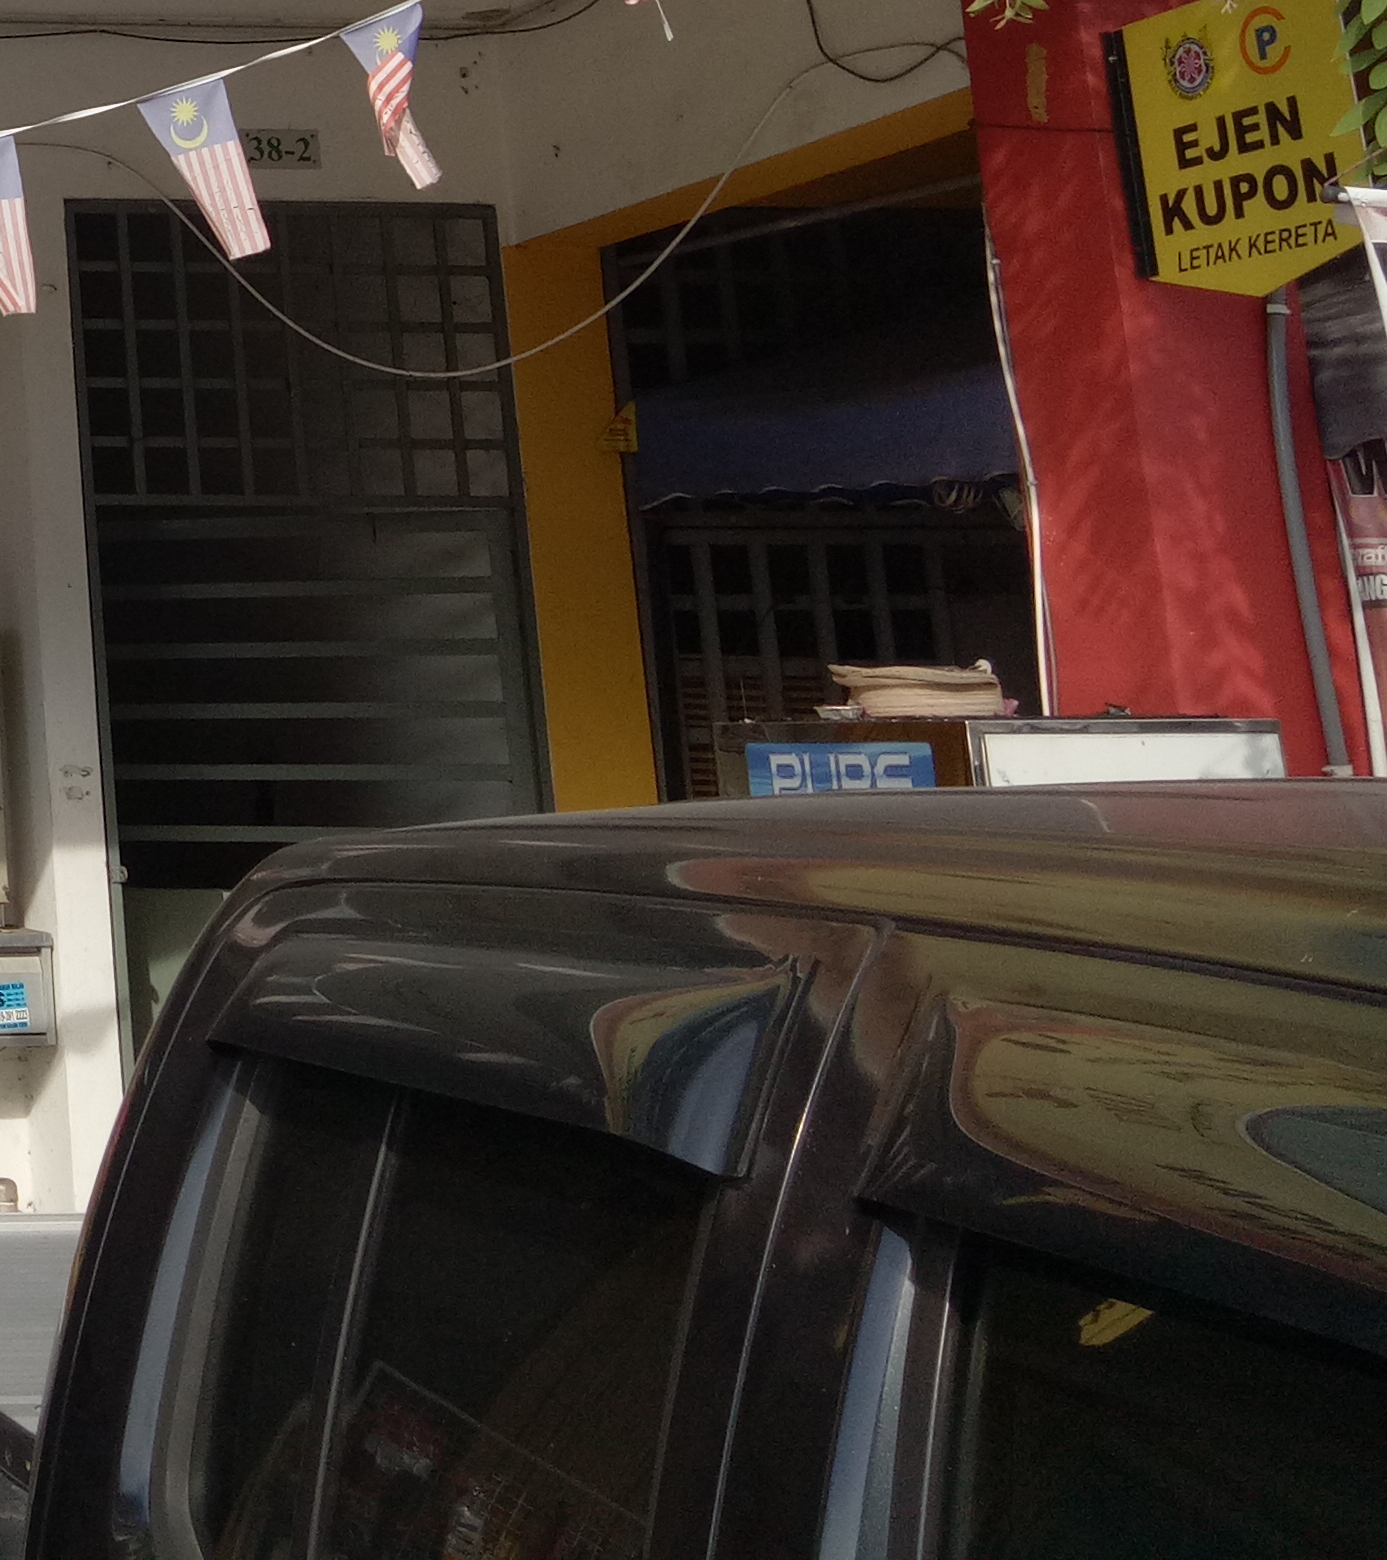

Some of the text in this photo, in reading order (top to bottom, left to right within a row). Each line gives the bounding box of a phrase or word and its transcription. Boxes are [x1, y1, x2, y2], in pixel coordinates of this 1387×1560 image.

[247, 136, 313, 163] 38-2
[1173, 95, 1303, 170] EJEN
[1159, 152, 1340, 236] KUPON
[1177, 218, 1338, 273] LETAK KERETA
